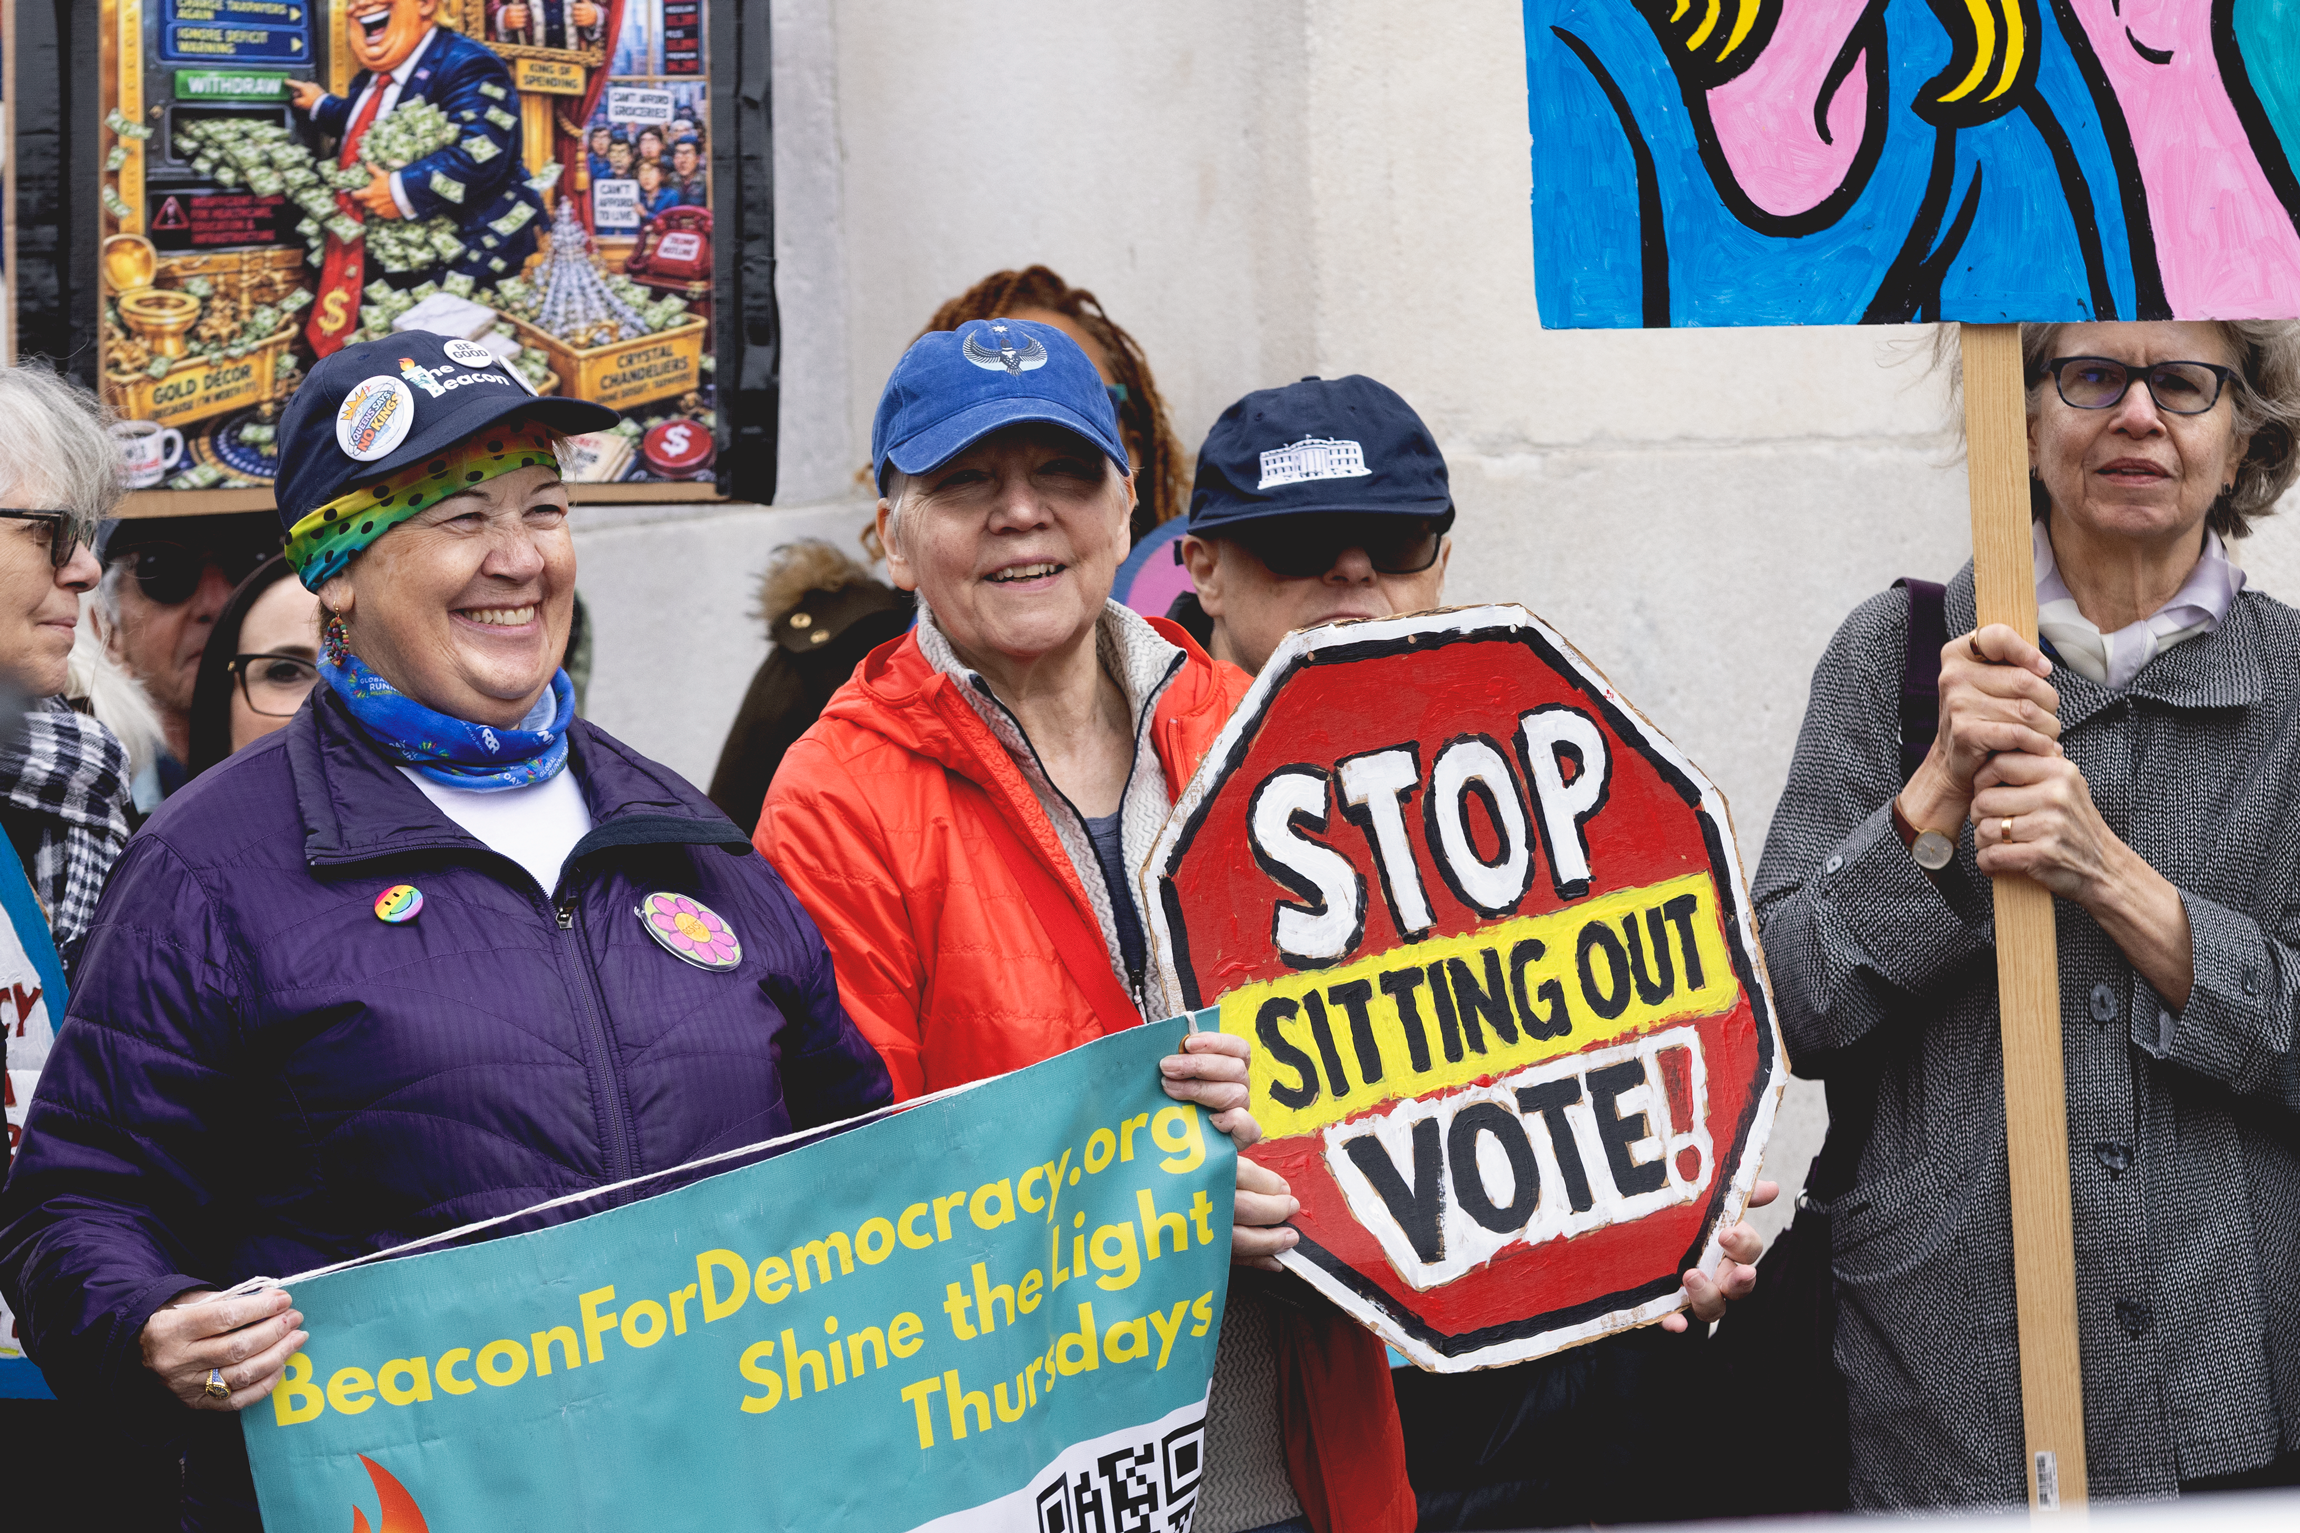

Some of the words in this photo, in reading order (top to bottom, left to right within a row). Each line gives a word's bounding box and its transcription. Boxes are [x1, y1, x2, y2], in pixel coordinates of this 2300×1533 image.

[530, 63, 555, 75] KING
[558, 65, 572, 75] OF
[187, 77, 283, 94] WITHDRAW
[523, 74, 578, 89] SPENDING
[613, 105, 667, 118] GROCERIES
[639, 94, 670, 105] AFFORD
[601, 184, 631, 195] CAN'T
[599, 198, 634, 207] AFFORD
[600, 210, 610, 220] TO
[613, 210, 633, 221] LIVE
[452, 349, 488, 360] GOOD
[454, 343, 475, 351] BE
[617, 345, 674, 369] CRYSTAL
[402, 365, 455, 389] The
[600, 355, 688, 390] CHANDELIERS
[153, 379, 197, 404] GOLD
[422, 373, 510, 399] Beacon
[352, 408, 376, 442] QUEENS
[372, 391, 391, 411] SAYS
[357, 428, 376, 453] NO
[370, 393, 403, 431] KINGS
[359, 676, 388, 685] GLOBA
[502, 772, 522, 786] DAY
[1250, 706, 1610, 966] STOP
[1254, 938, 1575, 1111] SITTING
[1577, 893, 1706, 1022] OUT
[1343, 1044, 1706, 1266] VOTE!
[271, 1105, 1206, 1427] BeaconForDemocracy.org
[739, 1311, 925, 1414] Shine
[943, 1262, 1043, 1341] the
[1051, 1187, 1215, 1293] Light
[901, 1290, 1214, 1451] Thursdays
